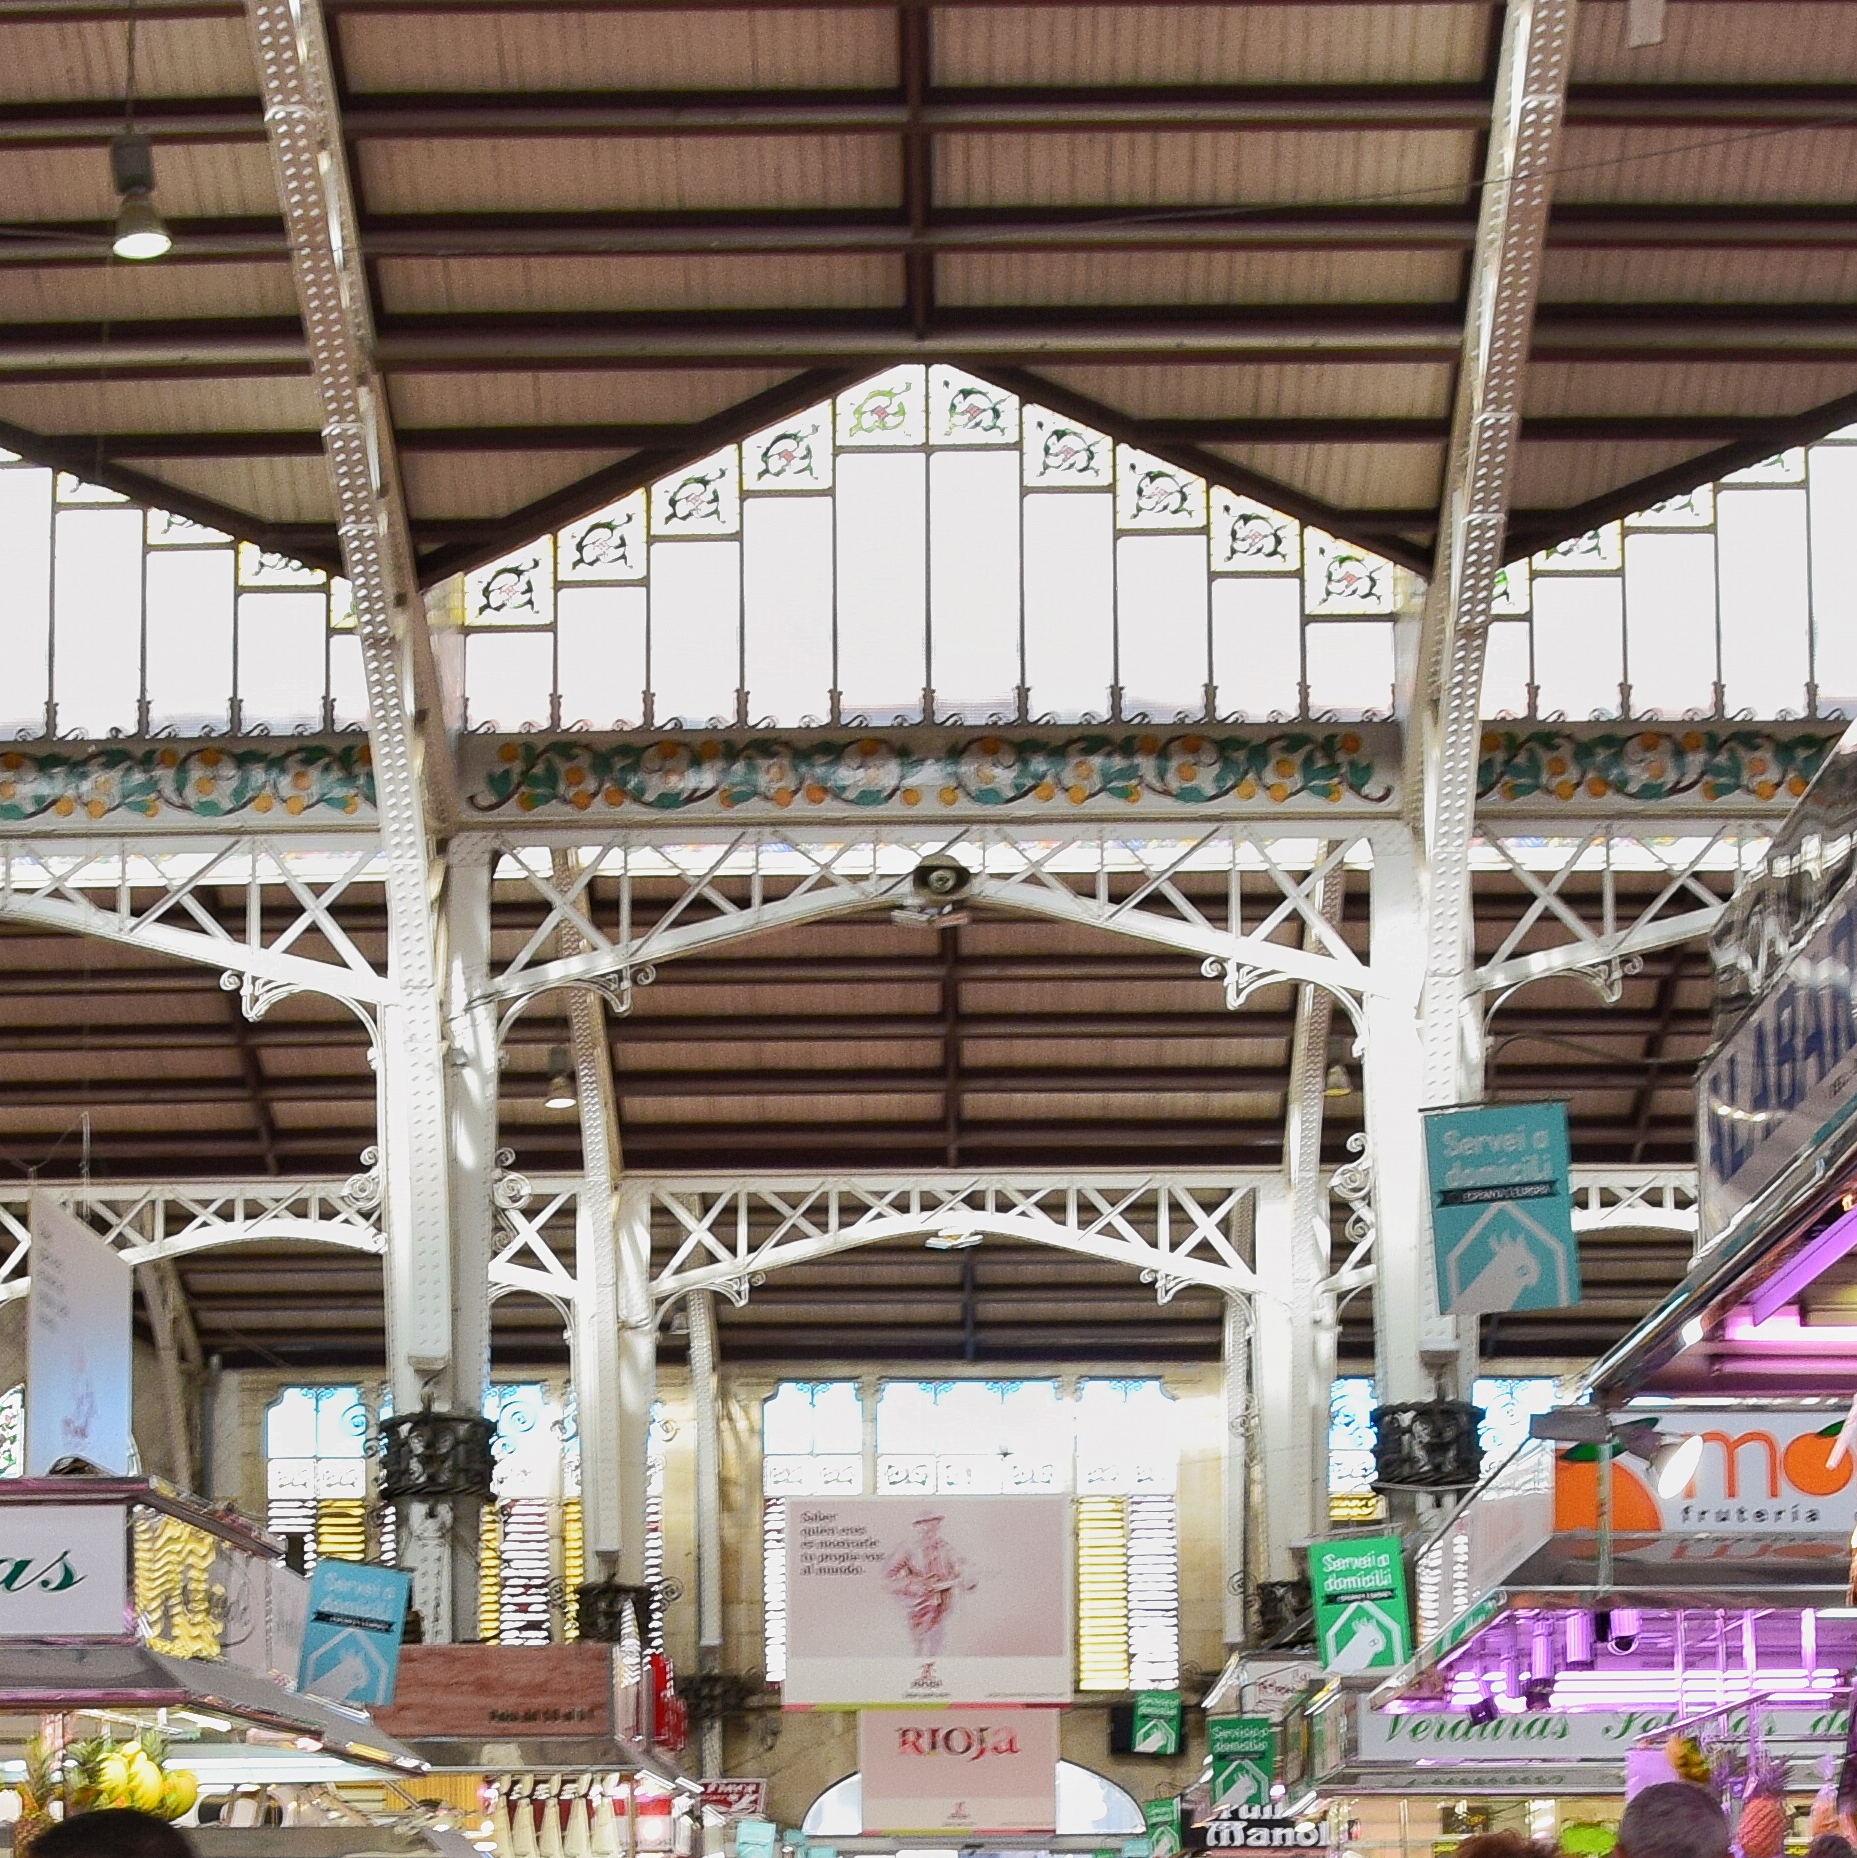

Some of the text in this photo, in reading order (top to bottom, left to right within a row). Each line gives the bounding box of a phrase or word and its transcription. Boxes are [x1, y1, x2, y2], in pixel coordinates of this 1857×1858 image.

[1444, 1124, 1527, 1157] Servei
[1680, 1504, 1821, 1524] frutería
[1323, 1551, 1375, 1573] Servei
[1324, 1569, 1392, 1591] domicili
